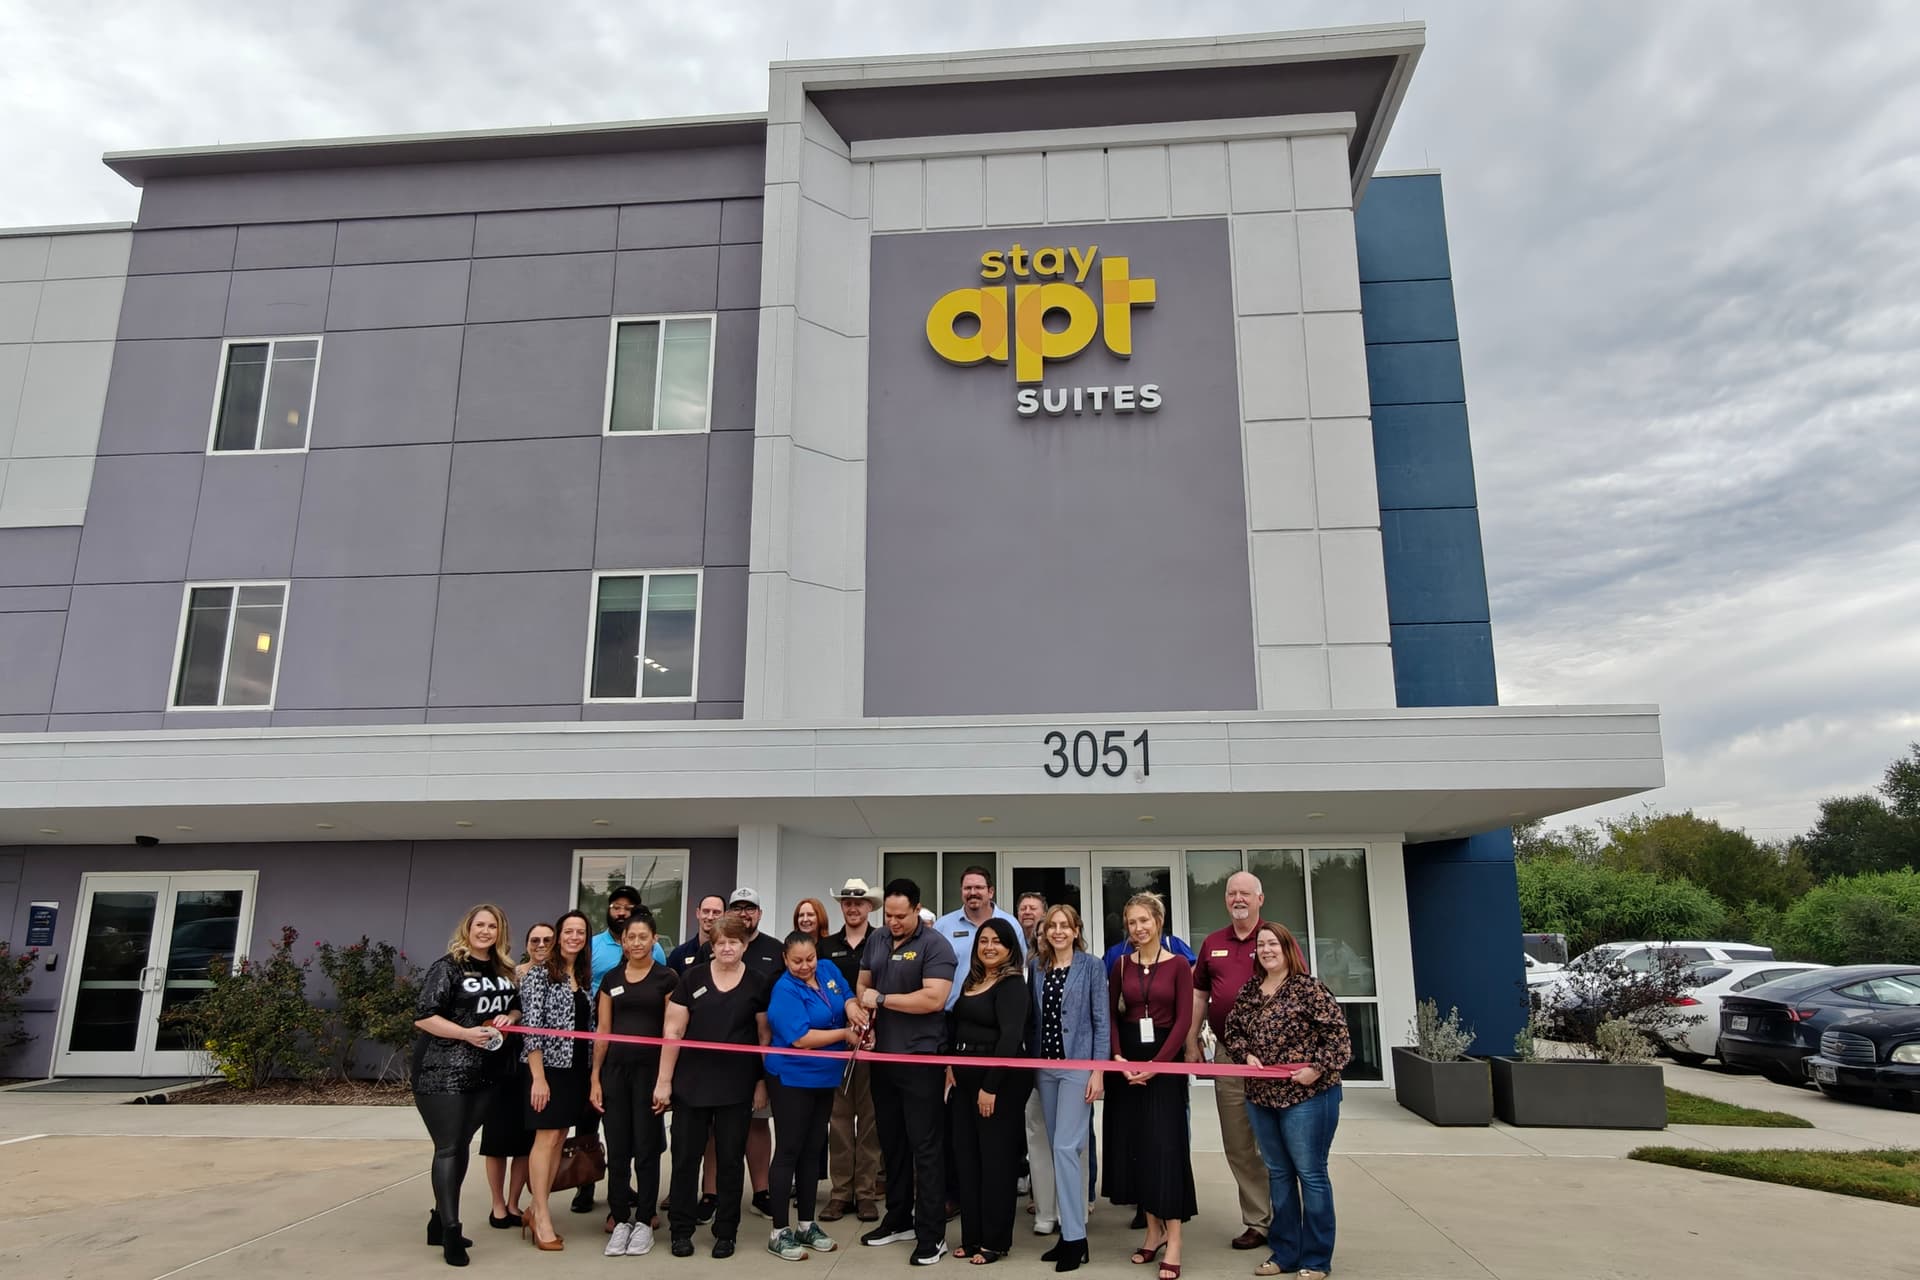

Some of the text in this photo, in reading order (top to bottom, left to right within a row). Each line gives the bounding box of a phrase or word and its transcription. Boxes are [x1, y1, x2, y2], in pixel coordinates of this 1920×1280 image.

[980, 243, 1098, 283] stay
[926, 256, 1157, 384] apt
[1016, 384, 1162, 415] SUITES
[1044, 729, 1149, 778] 3051
[463, 976, 516, 993] GAM
[476, 994, 514, 1014] DAY
